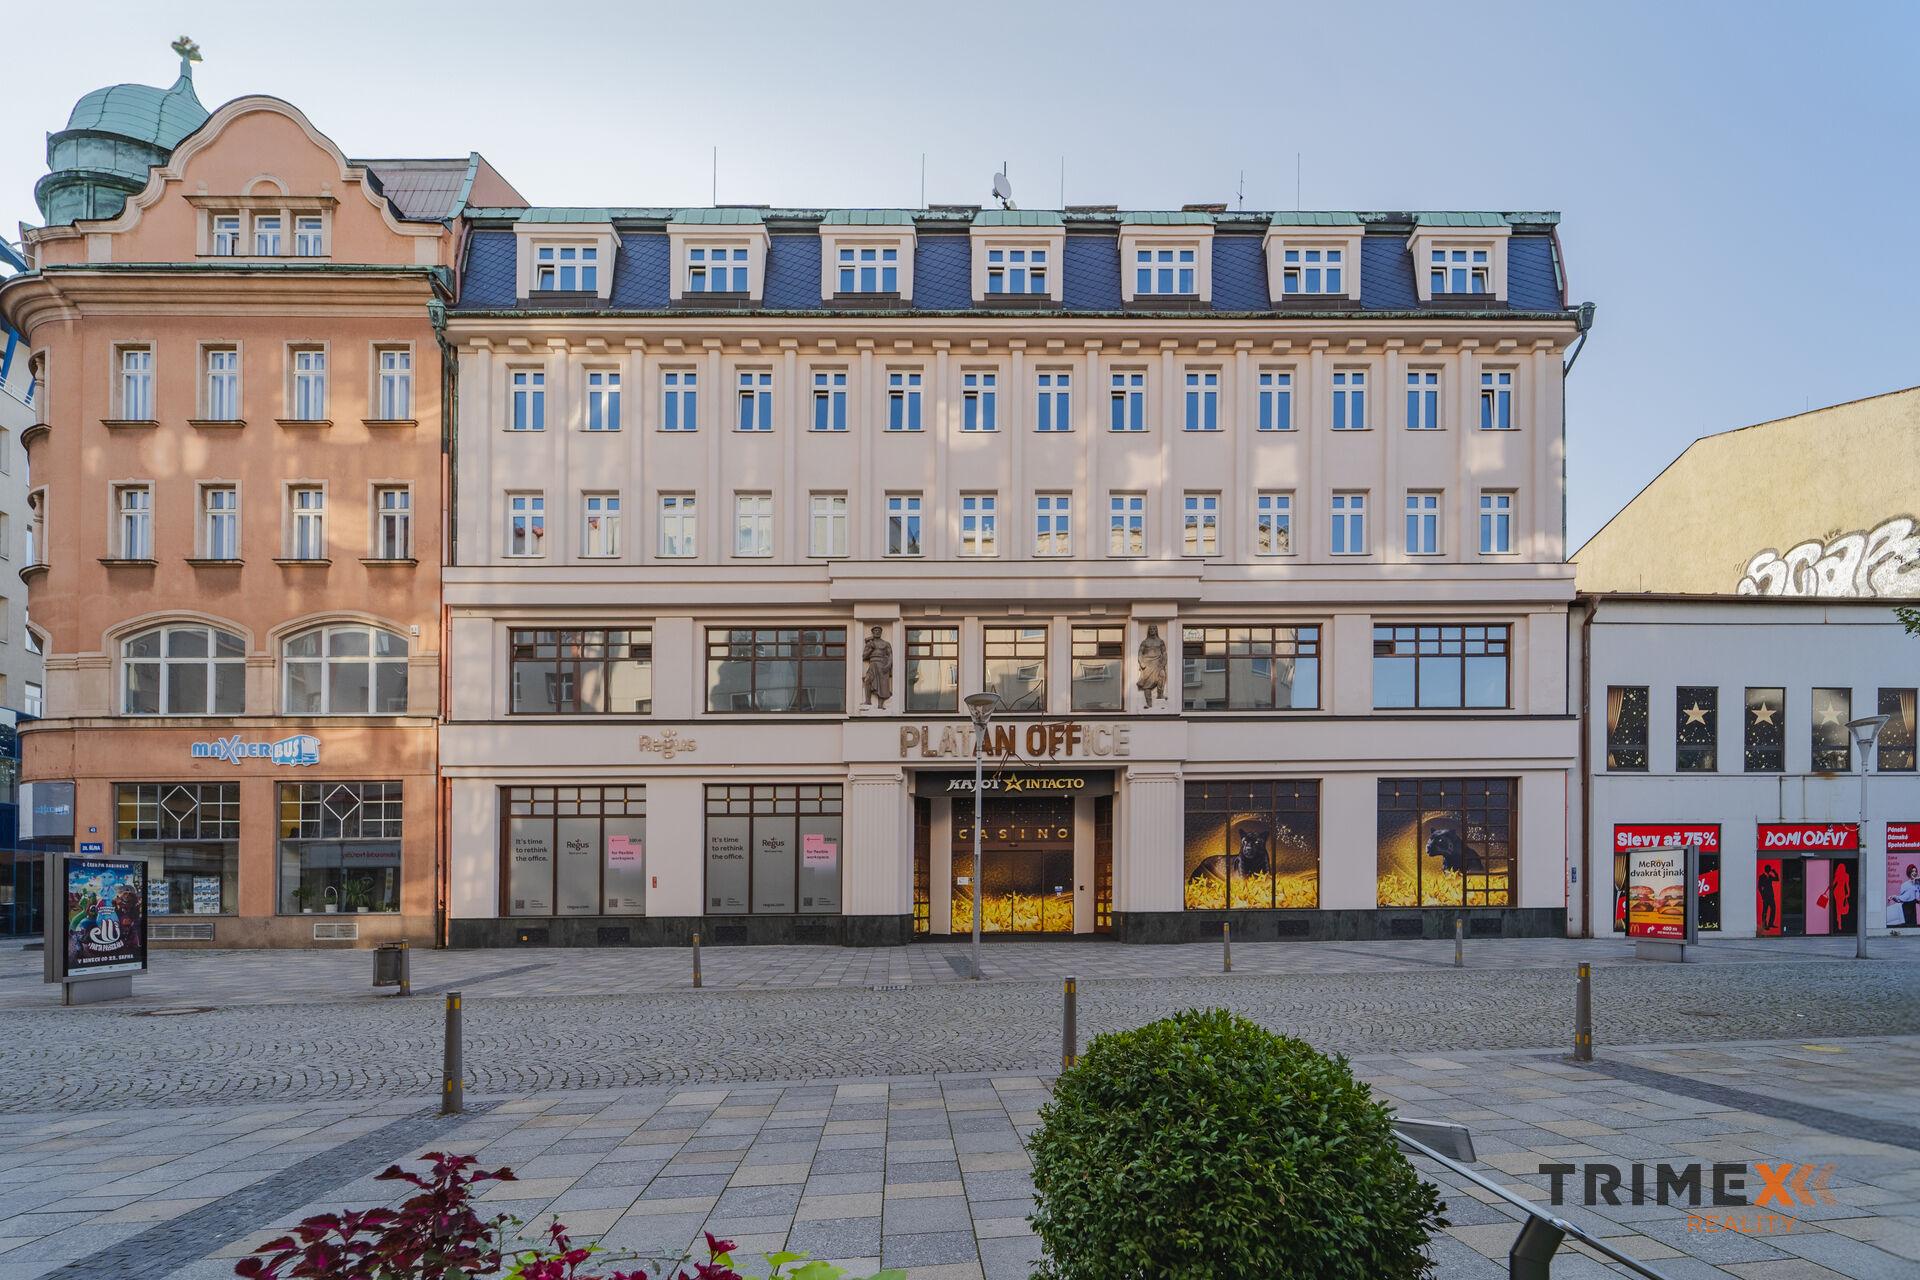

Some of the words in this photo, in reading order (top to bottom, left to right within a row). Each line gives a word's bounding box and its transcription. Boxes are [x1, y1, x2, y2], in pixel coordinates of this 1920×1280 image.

[639, 729, 697, 759] Regus
[900, 725, 1015, 757] PLATAN
[1026, 725, 1130, 757] OFFICE
[946, 778, 1000, 793] KAJOT
[1025, 778, 1085, 789] INTACTO
[958, 828, 1068, 839] CASINO
[1617, 832, 1660, 848] Slevy
[1664, 832, 1681, 846] až
[1684, 832, 1717, 846] 75%
[1765, 831, 1801, 846] DOMI
[1803, 829, 1848, 846] ODĚVY
[566, 838, 590, 851] Regus
[762, 837, 785, 849] Regus
[1638, 860, 1674, 868] McRoyal
[1630, 868, 1661, 877] dvakrát
[1662, 868, 1685, 878] jinak
